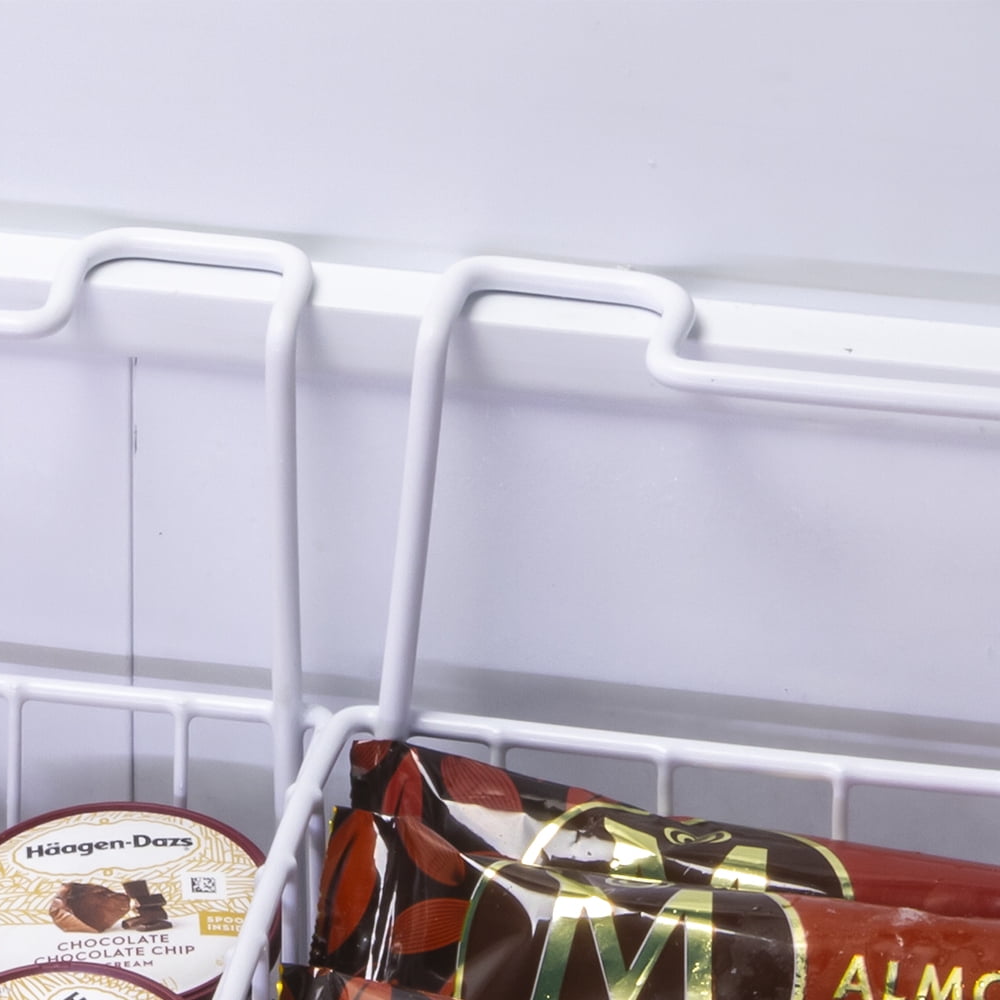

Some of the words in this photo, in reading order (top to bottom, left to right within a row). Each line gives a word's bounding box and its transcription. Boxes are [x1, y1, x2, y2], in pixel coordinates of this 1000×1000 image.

[26, 834, 193, 860] Häagen-Dazs
[206, 915, 243, 925] SPOO
[57, 934, 169, 952] CHOCOLATE
[151, 945, 195, 956] CHIP
